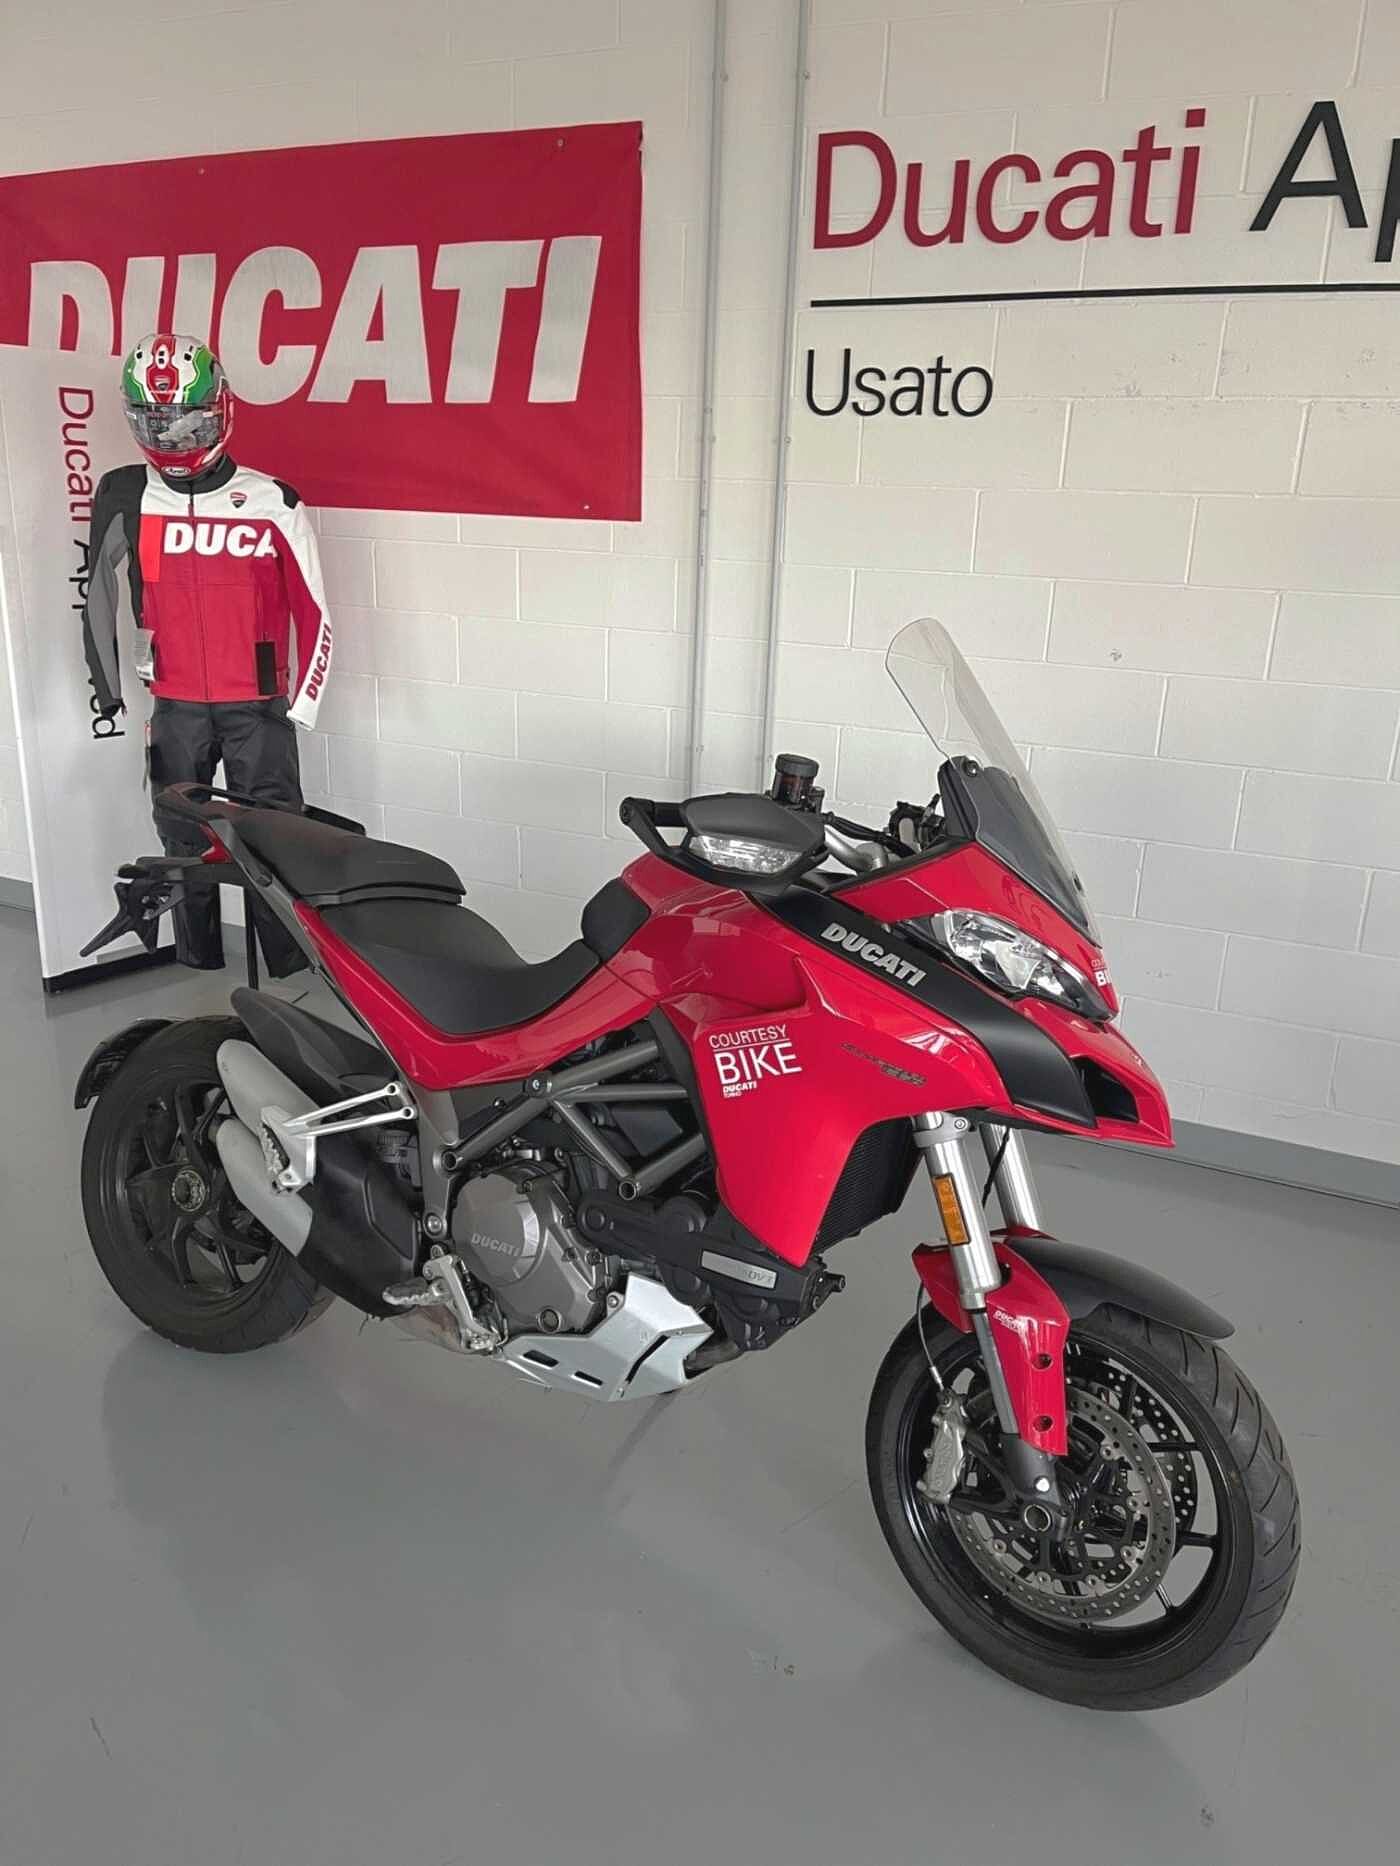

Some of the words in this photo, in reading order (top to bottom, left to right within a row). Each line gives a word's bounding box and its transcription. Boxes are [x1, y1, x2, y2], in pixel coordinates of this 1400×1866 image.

[812, 107, 1206, 249] Ducati
[27, 235, 602, 405] DUCATI
[805, 348, 993, 417] Usato
[58, 386, 95, 522] Ducati
[305, 623, 332, 702] DUCATI
[820, 922, 927, 987] DUCATI
[709, 1024, 787, 1048] COURTESY
[714, 1042, 802, 1085] BIKE
[723, 1080, 757, 1093] DUCATI
[471, 1232, 520, 1256] DUCATI
